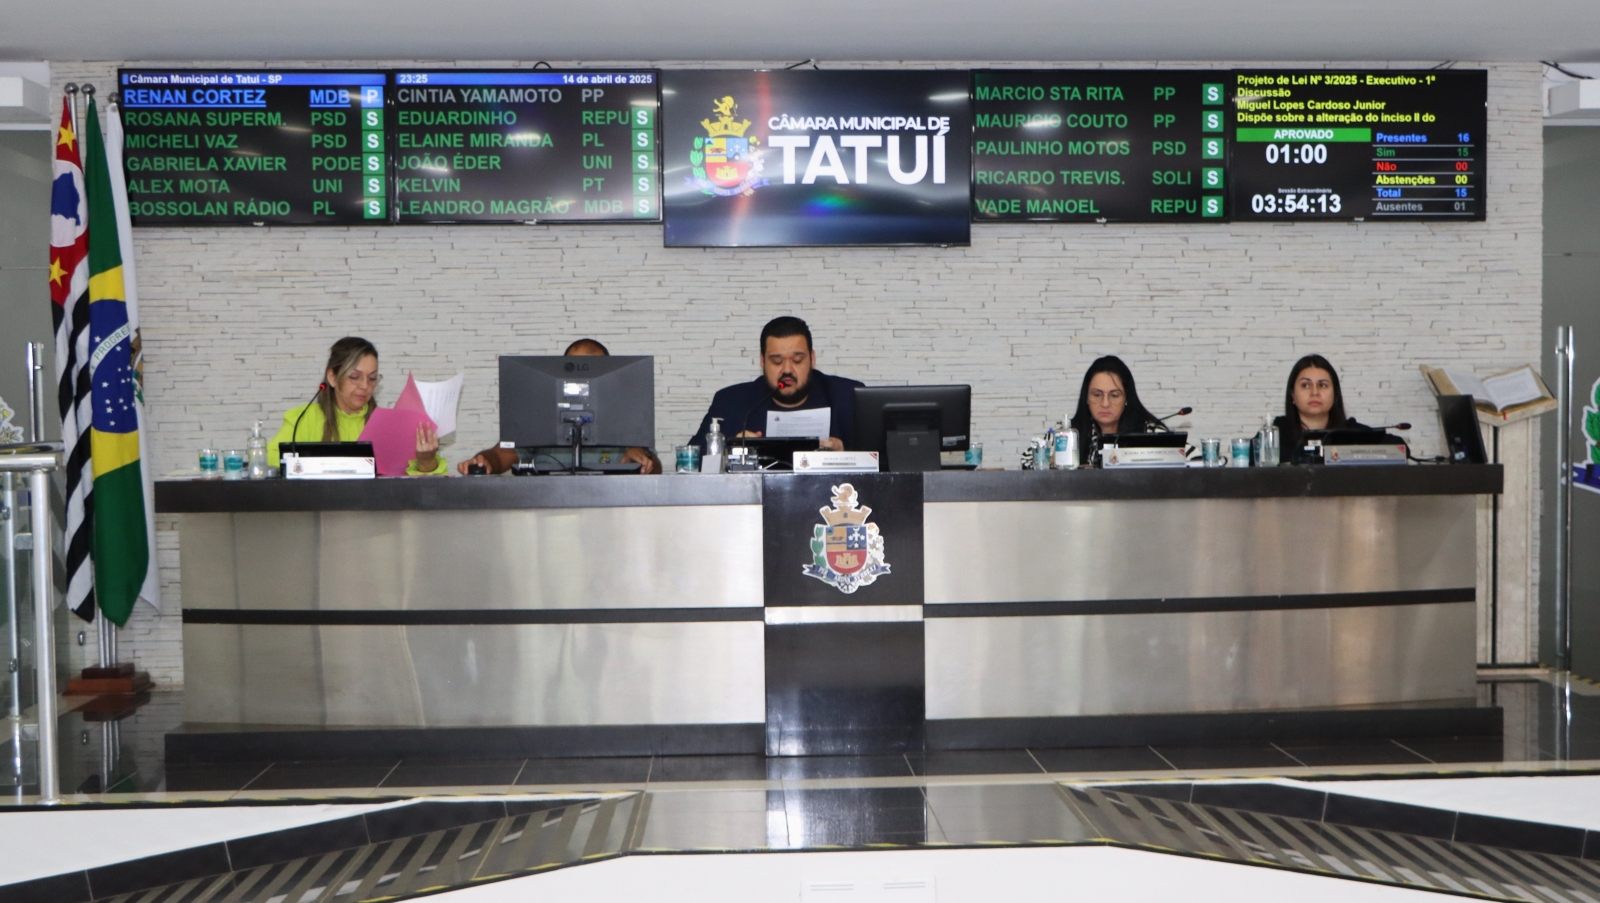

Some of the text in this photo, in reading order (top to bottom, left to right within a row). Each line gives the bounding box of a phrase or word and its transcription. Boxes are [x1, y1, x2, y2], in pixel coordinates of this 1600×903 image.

[130, 74, 168, 84] Câmara
[170, 74, 219, 85] Municipal
[221, 75, 233, 84] de
[268, 75, 282, 84] SP
[399, 75, 428, 83] 23:25
[563, 75, 652, 83] 14 de abril de 2025
[1238, 76, 1274, 86] Projeto
[1277, 76, 1289, 85] de
[1292, 76, 1307, 85] Lei
[1310, 76, 1322, 85] Nº
[1325, 76, 1357, 85] 3/2025
[1366, 76, 1416, 85] Executivo
[1426, 76, 1436, 85] 1ª
[124, 90, 266, 103] RENAN CORTEZ
[310, 90, 351, 104] MDB
[367, 90, 378, 102] P
[398, 89, 562, 103] CINTIA YAMAMOTO
[582, 89, 604, 102] PP
[976, 87, 1124, 100] MARCIO STA RITA
[1154, 87, 1175, 100] PP
[1208, 87, 1219, 101] S
[1238, 88, 1291, 97] Discussão
[1238, 101, 1386, 111] Miguel Lopes Cardoso Junior
[125, 112, 286, 126] ROSANA SUPERM.
[311, 112, 346, 126] PSD
[367, 112, 378, 126] S
[399, 111, 517, 125] EDUARDINHO
[583, 111, 629, 125] REPU
[637, 111, 648, 125] S
[768, 114, 949, 130] CÂMARA MUNICIPAL DE
[976, 114, 1128, 128] MAURICIO COUTO
[1154, 114, 1175, 127] PP
[1208, 114, 1219, 128] S
[1238, 113, 1273, 123] Dispõe
[1275, 113, 1304, 122] sobre
[1316, 113, 1363, 124] alteração
[1366, 113, 1378, 122] do
[1381, 113, 1412, 122] inciso
[1422, 114, 1435, 122] do
[126, 134, 238, 148] MICHELI VAZ
[312, 134, 347, 148] PSD
[367, 134, 379, 148] S
[399, 133, 553, 147] ELAINE MIRANDA
[583, 133, 604, 147] PL
[637, 133, 648, 147] S
[1274, 130, 1333, 139] APROVADO
[1376, 133, 1469, 144] Presentes 16
[976, 141, 1130, 155] PAULINHO MOTOS
[1153, 141, 1186, 155] PSD
[1208, 141, 1219, 155] S
[1266, 144, 1327, 164] 01:00
[1376, 148, 1468, 157] Sim 15
[127, 157, 286, 171] GABRIELA XAVIER
[312, 157, 361, 171] PODE
[367, 157, 379, 171] S
[399, 152, 501, 170] JOÃO ÉDER
[583, 156, 612, 169] UNI
[638, 155, 649, 169] S
[768, 129, 950, 185] TATUÍ
[1376, 161, 1467, 171] Não 00
[583, 178, 604, 191] PT
[638, 178, 649, 191] S
[976, 171, 1125, 185] RICARDO TREVIS.
[1152, 171, 1191, 185] SOLI
[1208, 171, 1218, 185] S
[1376, 175, 1467, 186] Abstenções 00
[128, 180, 230, 193] ALEX MOTA
[313, 180, 342, 193] UNI
[368, 179, 380, 193] S
[399, 179, 460, 192] KELVIN
[1376, 188, 1467, 198] Total 15
[130, 198, 290, 216] BOSSOLAN RÁDIO
[313, 202, 335, 215] PL
[369, 201, 380, 215] S
[399, 197, 569, 214] LEANDRO MAGRÃO
[585, 200, 623, 214] MDB
[638, 199, 650, 214] S
[976, 200, 1020, 213] VADE
[1027, 199, 1099, 213] MANOEL
[1151, 200, 1197, 213] REPU
[1207, 199, 1218, 213] S
[1252, 195, 1341, 213] 03:54:13
[1376, 202, 1466, 211] Ausentes 01
[577, 363, 589, 371] LG
